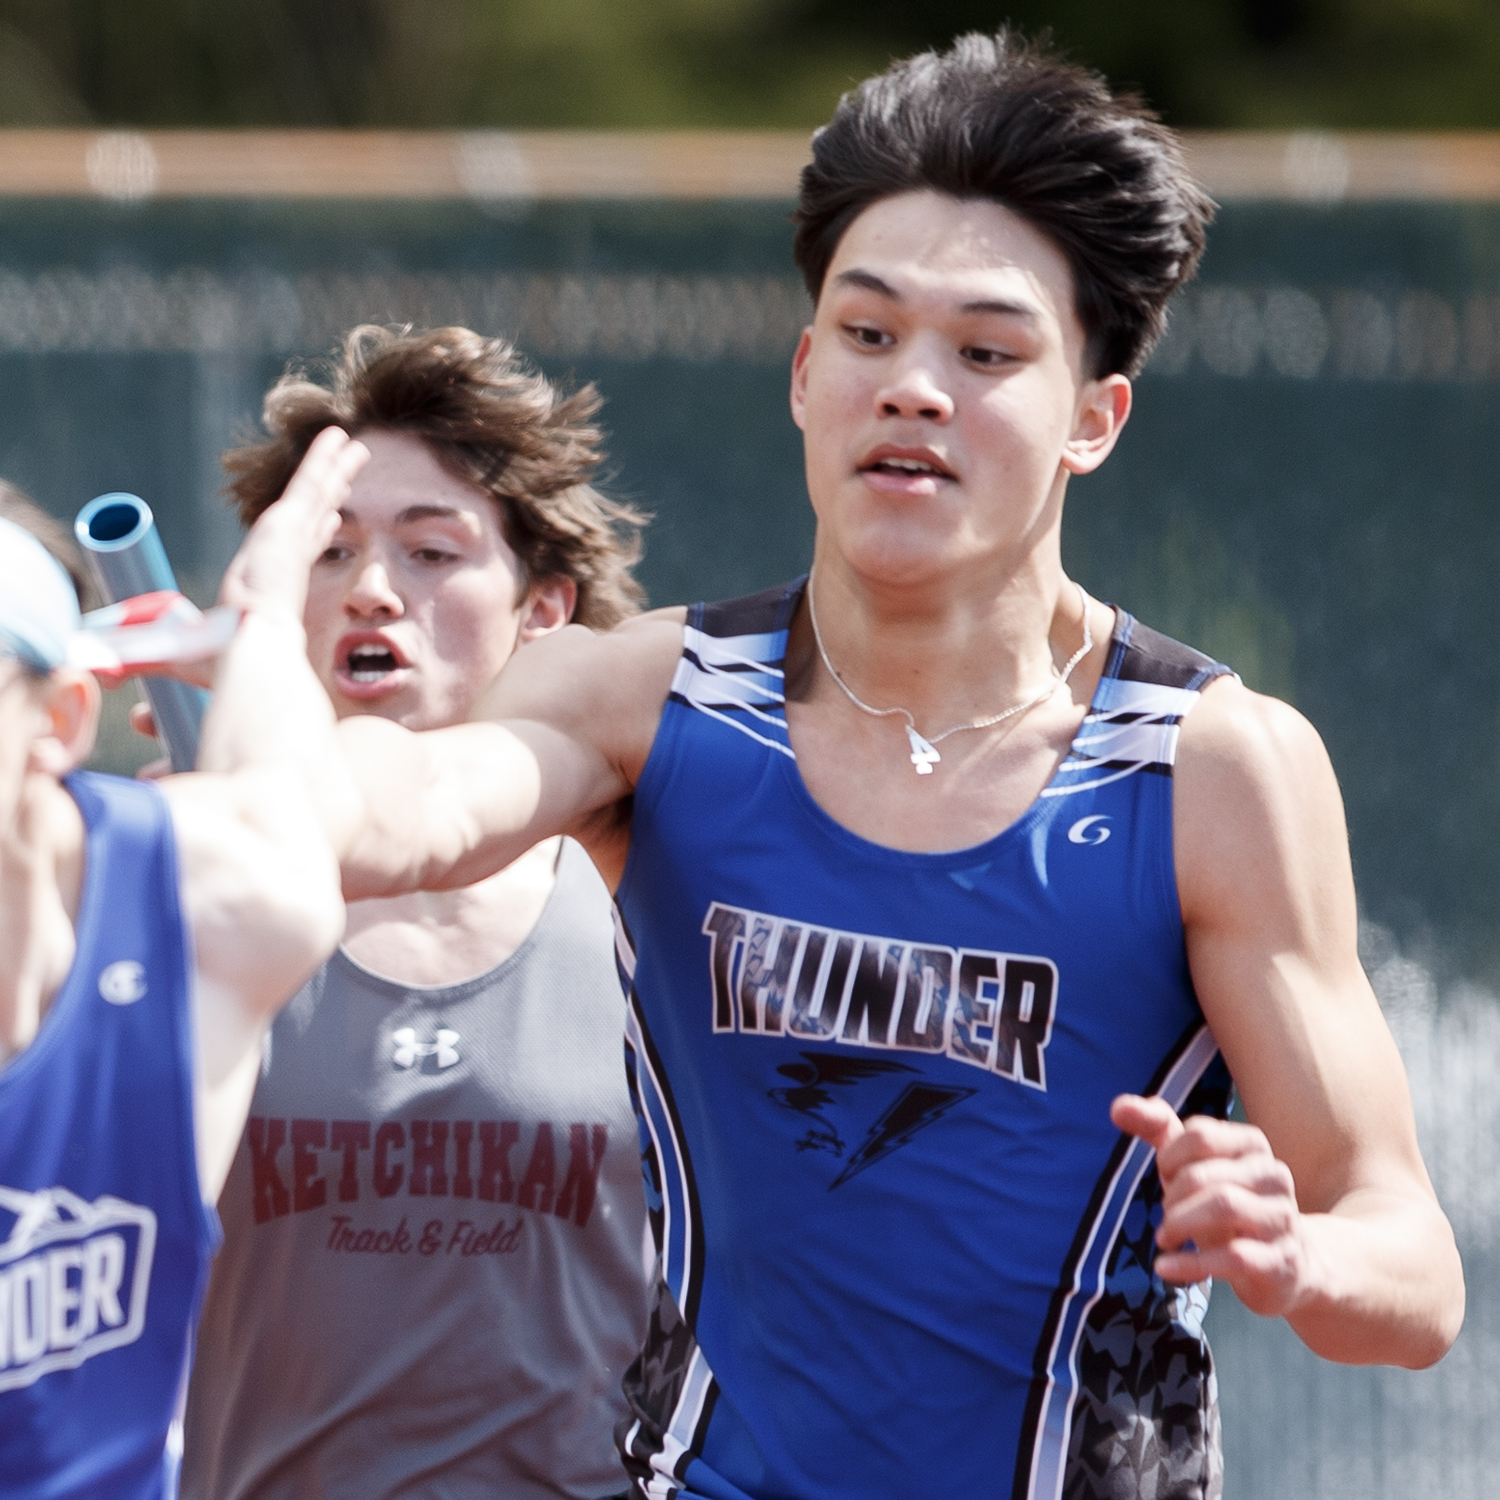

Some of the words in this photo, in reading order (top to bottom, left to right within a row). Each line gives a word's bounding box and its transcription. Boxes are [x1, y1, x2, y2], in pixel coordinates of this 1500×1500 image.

[702, 901, 1059, 1093] THUNDER
[248, 1116, 609, 1229] KETCHIKAN
[326, 1215, 413, 1255] Track
[418, 1218, 444, 1256] &
[448, 1217, 525, 1257] Field
